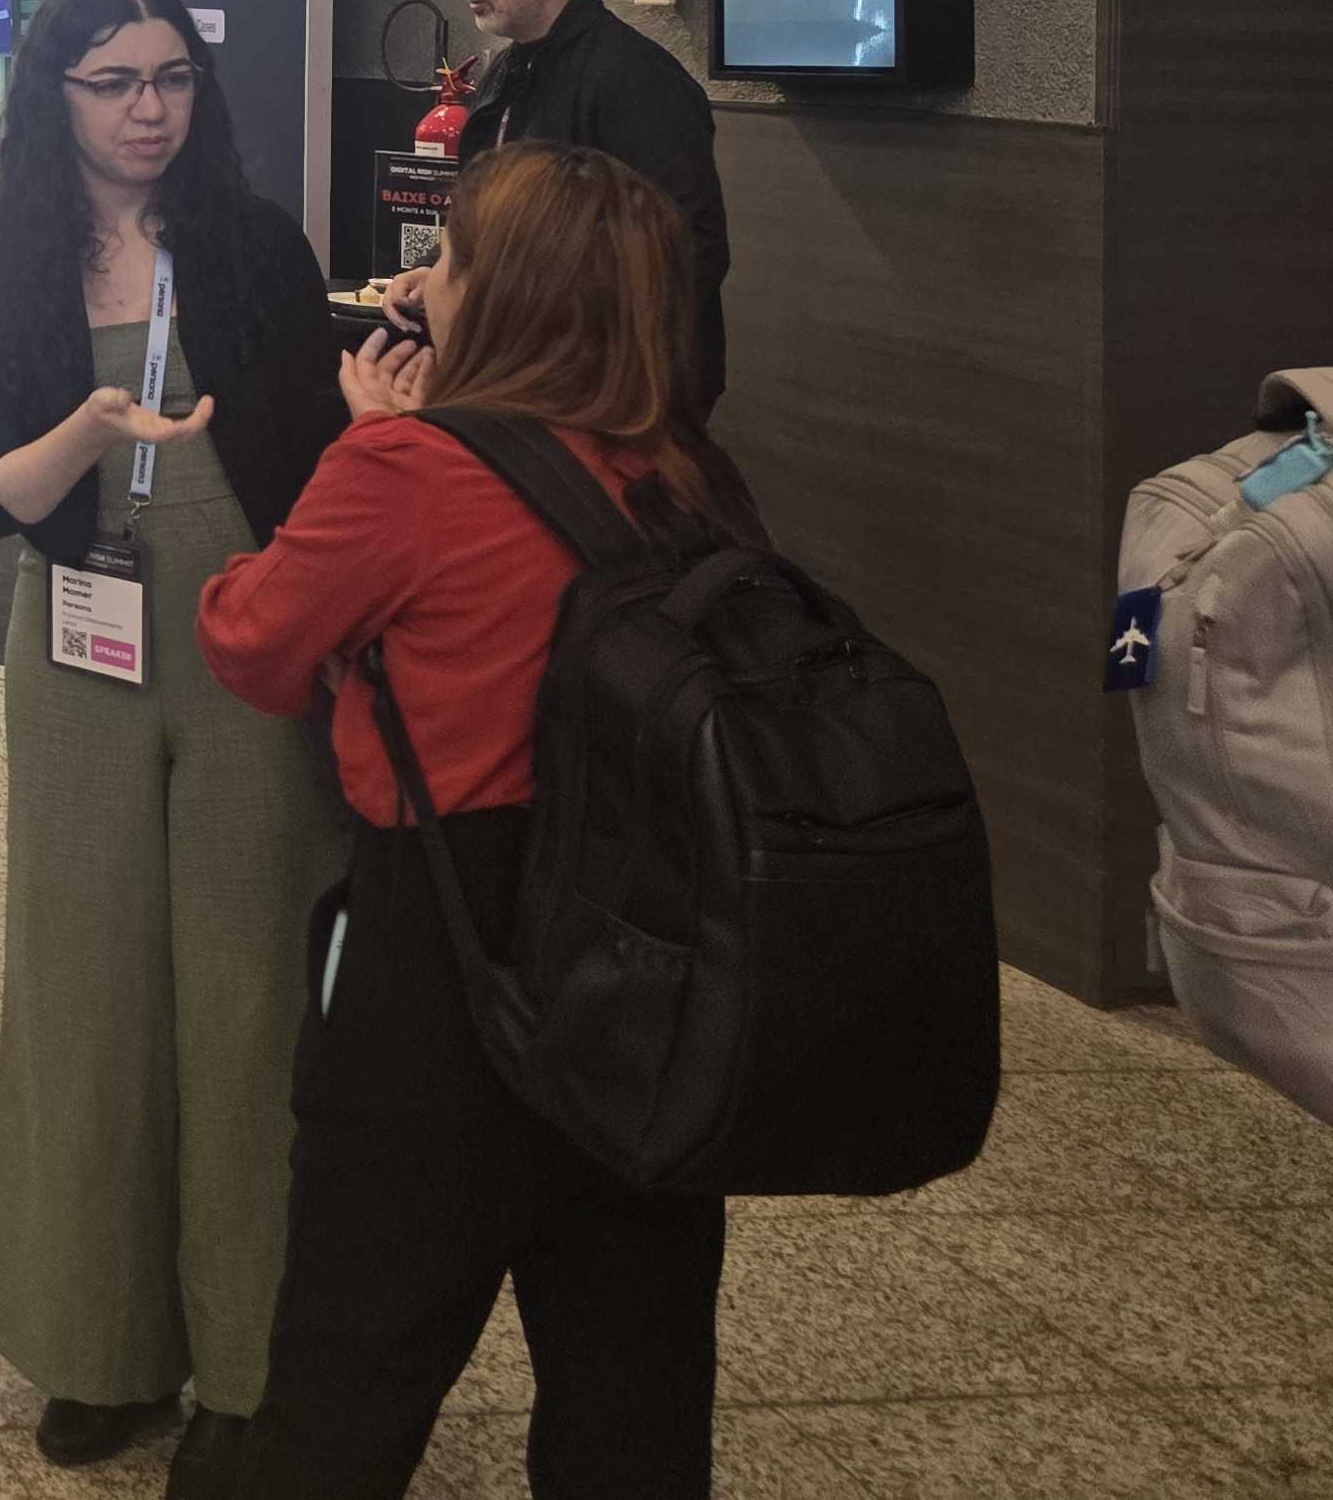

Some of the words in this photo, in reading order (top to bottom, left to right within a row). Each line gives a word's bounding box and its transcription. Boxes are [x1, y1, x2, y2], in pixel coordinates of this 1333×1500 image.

[390, 166, 416, 174] DIGITAL
[381, 189, 427, 204] BAIXE
[430, 194, 442, 205] O
[156, 282, 166, 317] persona
[147, 362, 157, 401] persona
[137, 444, 149, 485] persona
[94, 644, 133, 661] SPEAKER
